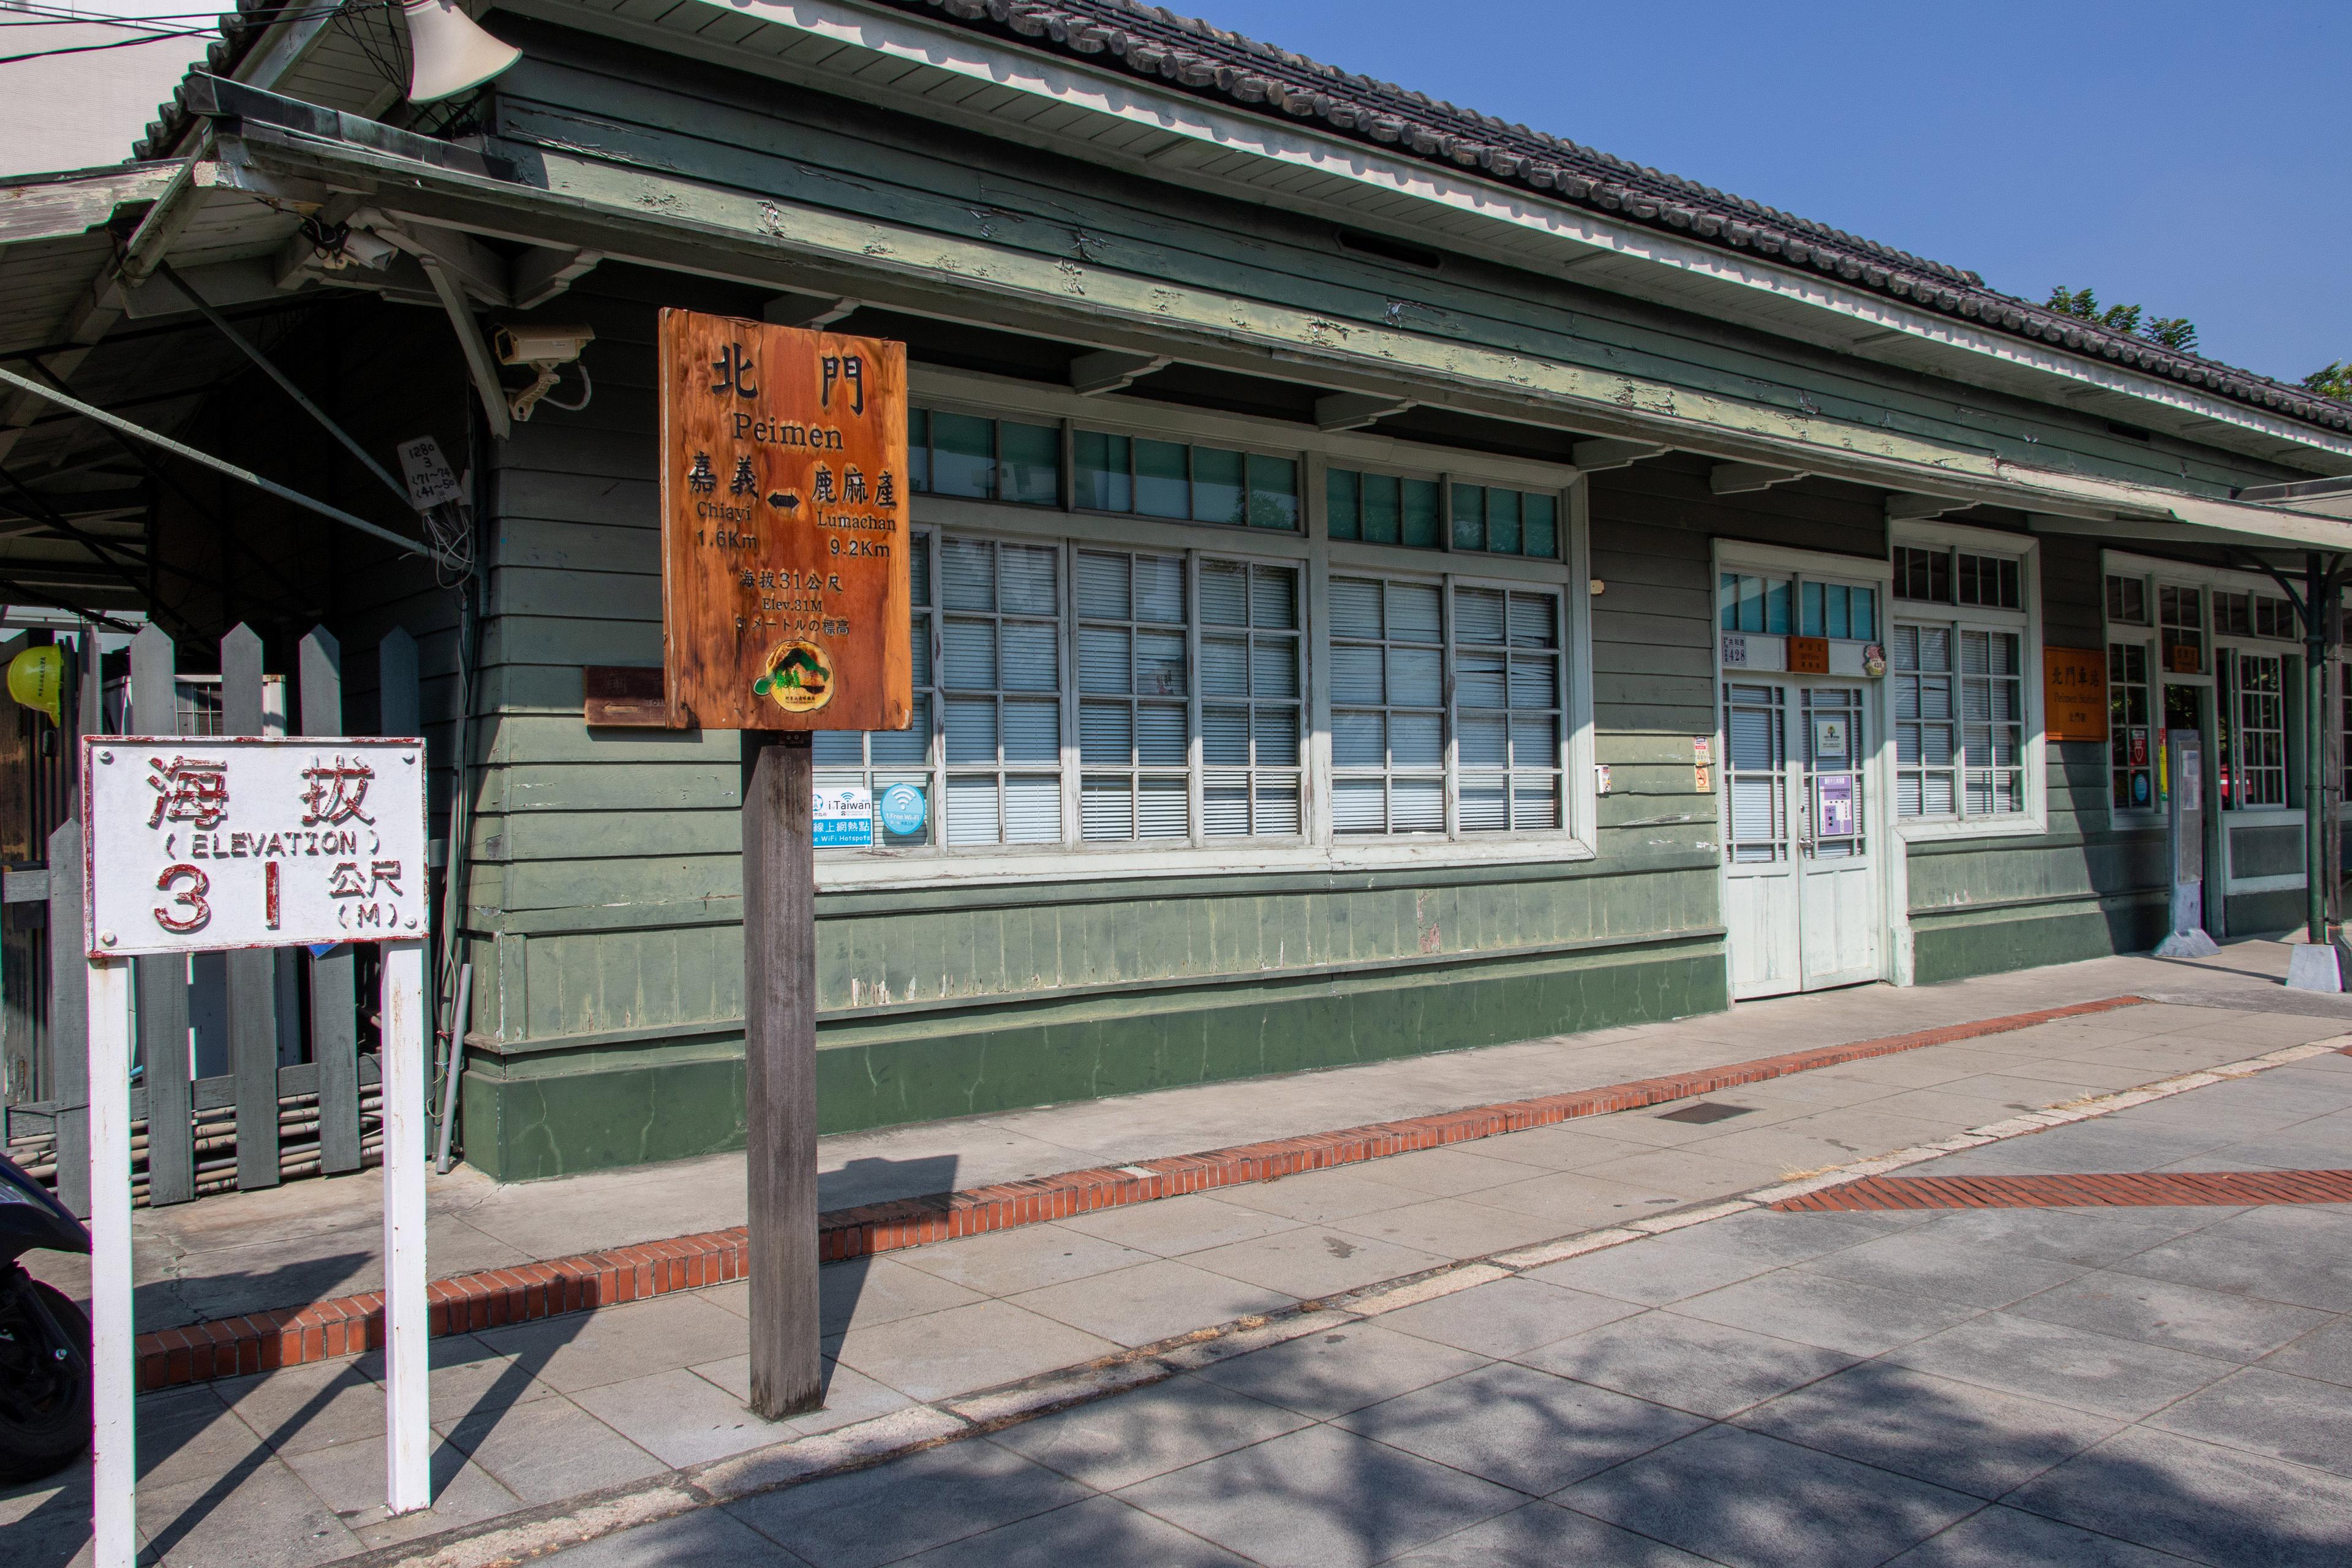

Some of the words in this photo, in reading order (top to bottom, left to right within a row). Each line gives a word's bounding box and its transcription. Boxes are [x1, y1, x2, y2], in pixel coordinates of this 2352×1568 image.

[712, 342, 864, 416] 北門
[734, 413, 843, 450] Peimen
[409, 443, 435, 459] 1280
[423, 457, 432, 467] 3
[688, 451, 759, 499] 嘉義
[811, 466, 897, 508] 鹿麻產
[697, 501, 751, 522] Chiayi
[817, 511, 897, 530] Lumachan
[697, 530, 758, 549] 1.6Km
[831, 539, 890, 558] 9.2Km
[739, 570, 843, 592] 海拔31公尺
[762, 598, 823, 612] Elev.31M
[1729, 649, 1745, 662] 428
[2052, 666, 2099, 687] 北門車站
[147, 755, 375, 827] 海拔
[166, 831, 380, 859] (ELEVATION)
[329, 860, 403, 897] 公尺
[154, 861, 280, 932] 31
[337, 902, 397, 929] (M)
